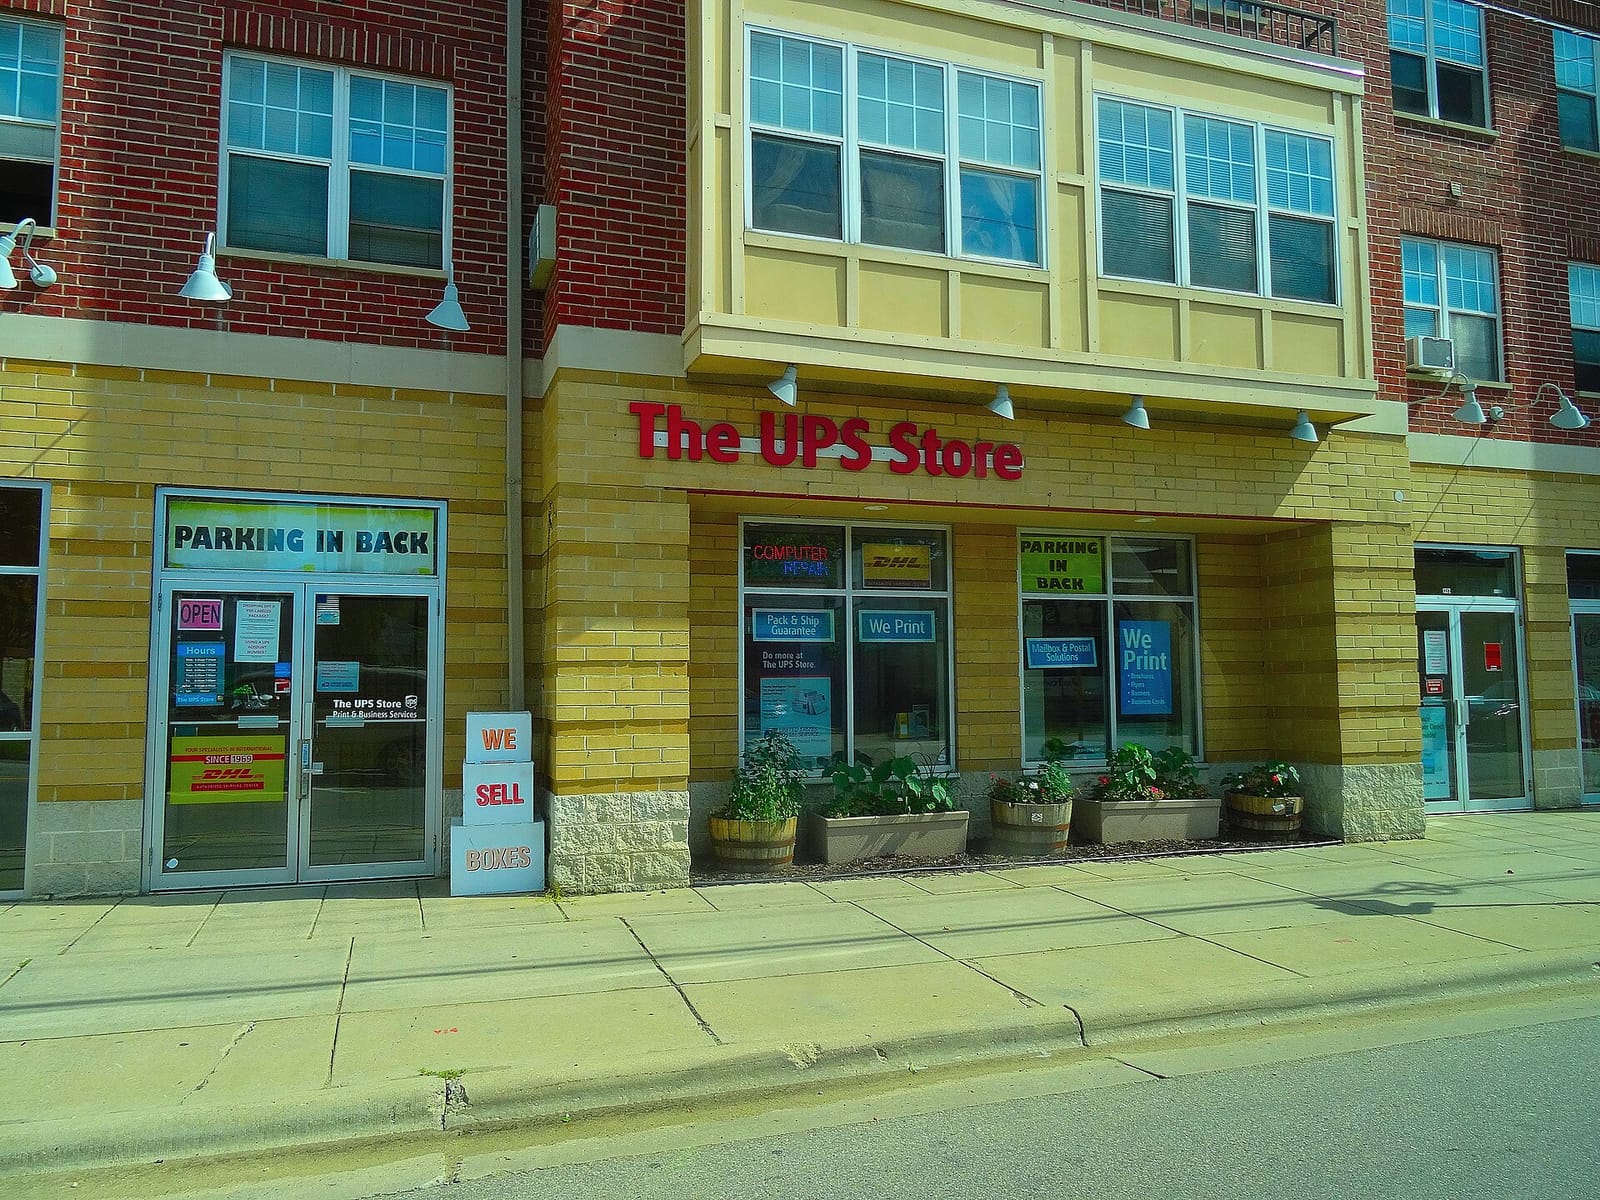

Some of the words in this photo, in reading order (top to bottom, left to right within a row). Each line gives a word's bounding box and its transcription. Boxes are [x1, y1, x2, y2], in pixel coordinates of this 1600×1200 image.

[629, 402, 741, 462] The
[760, 411, 872, 471] UPS
[889, 422, 1024, 480] Store
[174, 525, 304, 552] PARKING
[316, 529, 344, 553] IN
[356, 531, 429, 554] BACK
[753, 545, 829, 560] COMPUTER
[1020, 541, 1098, 554] PARKING
[783, 561, 830, 576] REPAIR
[871, 556, 921, 568] DHL
[1049, 559, 1067, 572] IN
[1036, 577, 1084, 590] BACK
[180, 604, 221, 624] OPEN
[767, 615, 788, 625] Pack
[791, 615, 798, 625] &
[800, 615, 819, 628] Ship
[869, 619, 891, 634] We
[895, 619, 926, 634] Print
[771, 625, 817, 636] Guarantee
[1122, 628, 1152, 649] We
[186, 646, 216, 655] Hours
[1031, 643, 1060, 653] Mailbox
[1061, 643, 1069, 653] &
[1069, 643, 1091, 652] Postal
[762, 651, 772, 660] Do
[774, 652, 794, 660] more
[795, 651, 803, 660] at
[1046, 653, 1079, 662] Solutions
[1123, 650, 1167, 670] Print
[762, 660, 777, 669] The
[778, 660, 794, 669] UPS
[332, 699, 352, 708] The
[354, 699, 374, 708] UPS
[376, 699, 402, 708] Store
[332, 710, 350, 718] Print
[351, 710, 358, 718] &
[358, 710, 388, 719] Business
[389, 710, 418, 719] Services
[481, 728, 517, 750] WE
[205, 755, 230, 764] SINCE
[231, 754, 253, 763] 1969
[202, 769, 254, 780] DHL
[475, 783, 525, 807] SELL
[465, 846, 531, 871] BOXES
